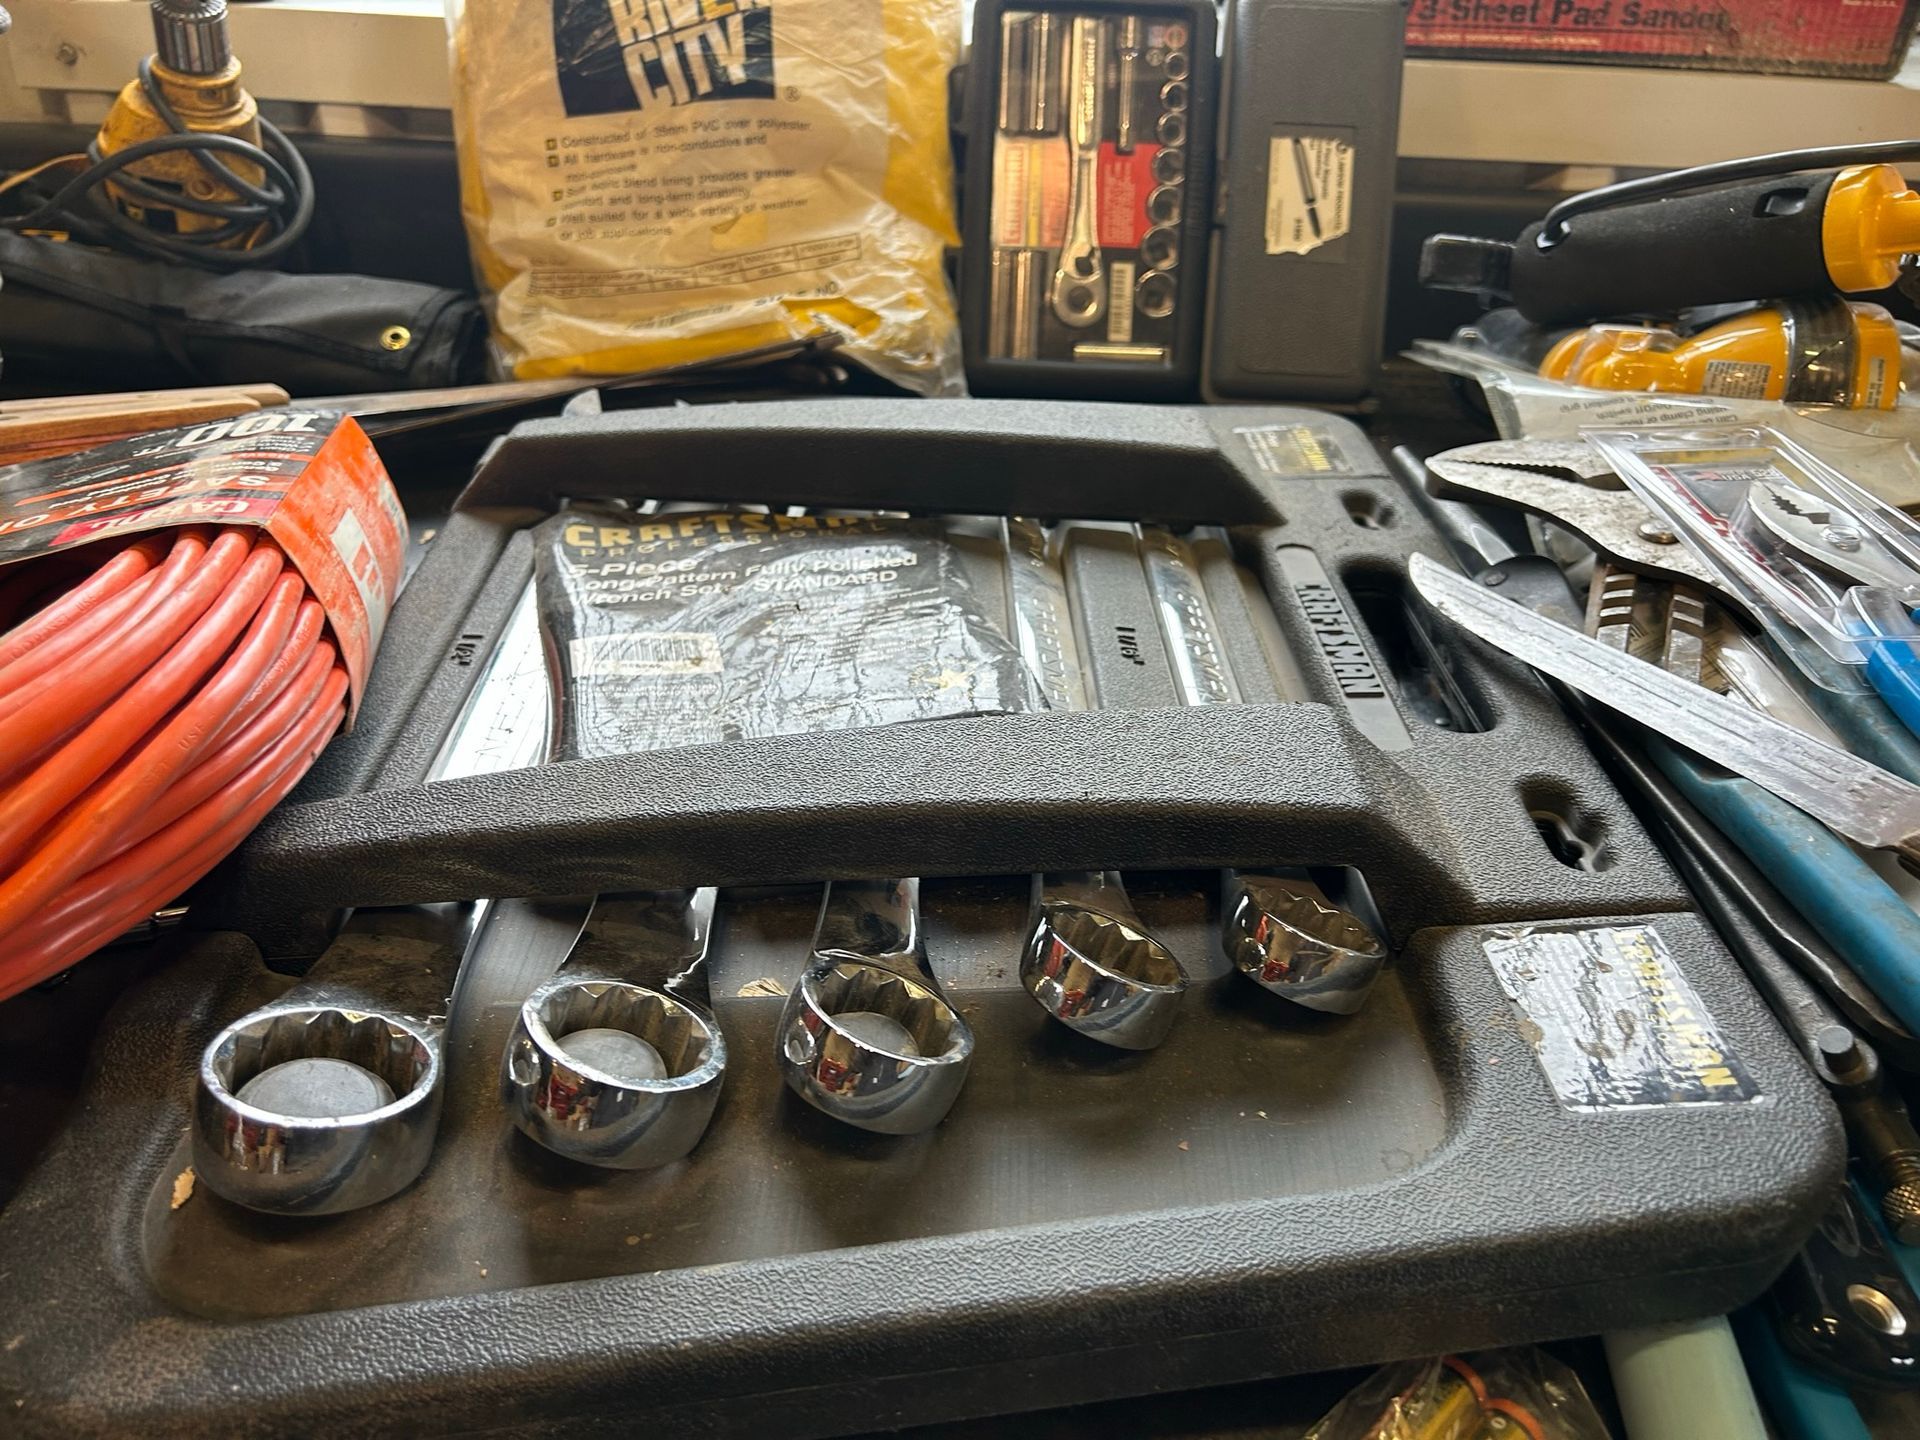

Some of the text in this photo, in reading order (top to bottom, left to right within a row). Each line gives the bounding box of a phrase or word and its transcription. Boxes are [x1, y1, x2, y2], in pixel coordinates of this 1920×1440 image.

[1551, 0, 1607, 25] Pad
[1620, 3, 1730, 32] Sander
[623, 12, 746, 107] CITY
[561, 132, 631, 148] Constructed
[692, 119, 720, 131] PVC
[724, 119, 751, 129] over
[583, 149, 637, 163] hardware
[656, 138, 741, 152] non-conductive
[743, 133, 767, 146] and
[623, 177, 658, 188] blend
[661, 176, 694, 187] lining
[698, 170, 749, 184] provides
[588, 210, 626, 223] suited
[632, 209, 649, 221] for
[761, 199, 809, 211] weather
[608, 195, 632, 206] and
[176, 413, 320, 448] 100
[1646, 416, 1658, 424] or
[1660, 410, 1694, 422] clamp
[65, 475, 271, 517] SAFETY
[91, 499, 250, 530] CAROL
[570, 557, 699, 578] 5-Piece
[744, 561, 807, 578] Fully
[812, 553, 918, 573] Polished
[573, 588, 672, 605] Wrench
[752, 569, 898, 593] STANDARD
[1293, 583, 1386, 699] CRAFTSMAN
